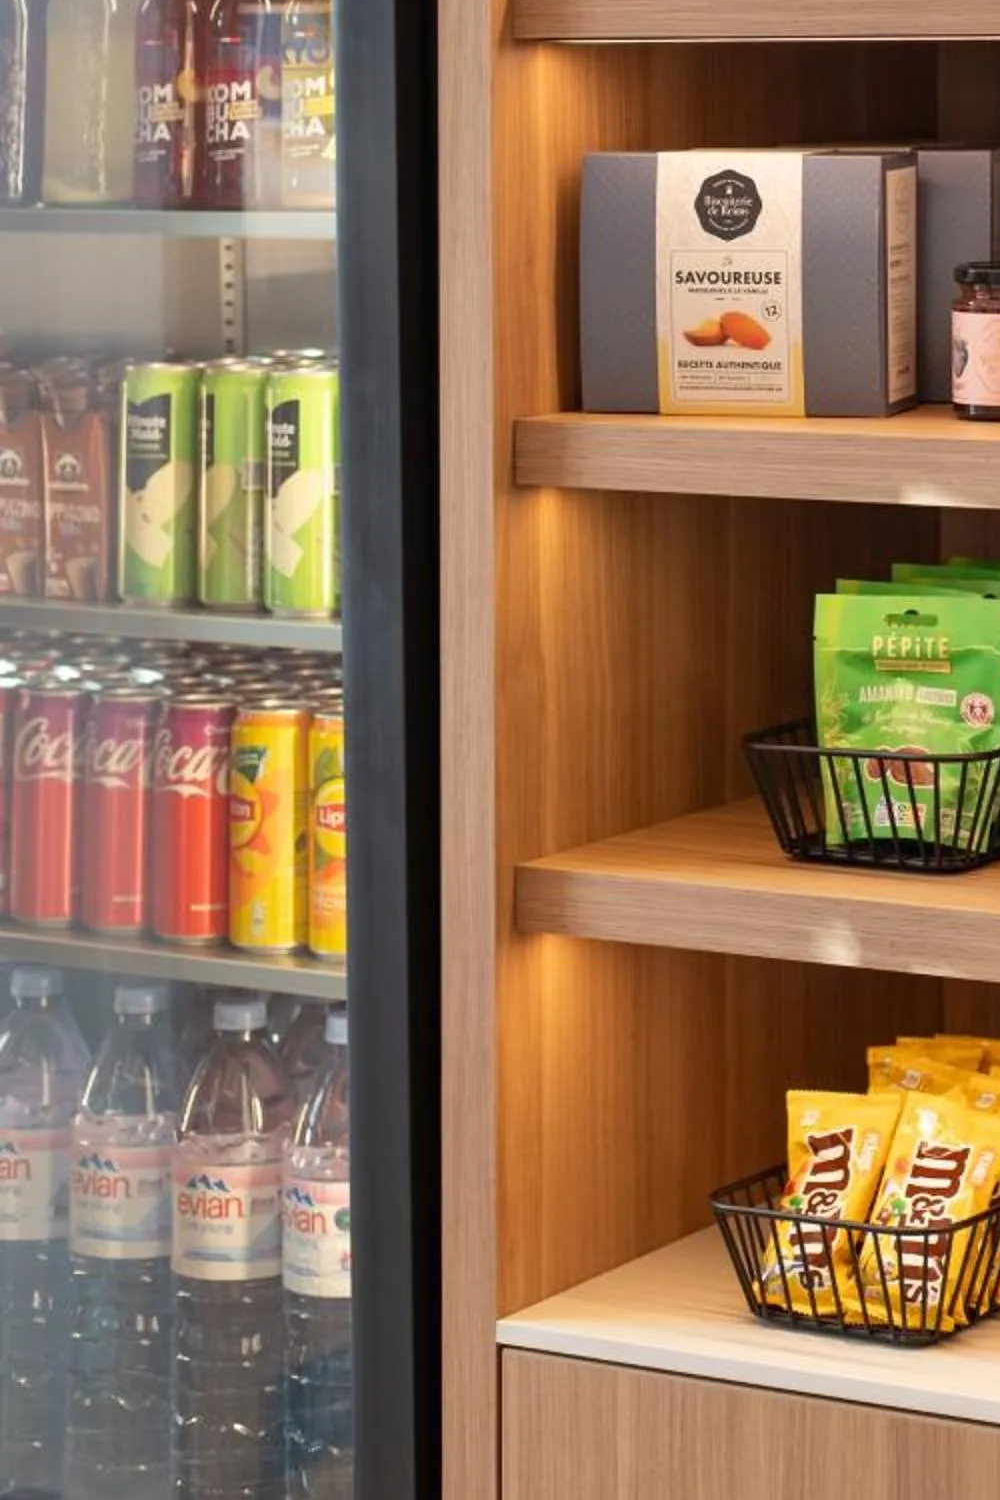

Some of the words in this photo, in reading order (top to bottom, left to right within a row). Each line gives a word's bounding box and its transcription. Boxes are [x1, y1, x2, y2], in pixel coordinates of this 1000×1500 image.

[139, 83, 173, 103] OM
[139, 120, 171, 143] HA
[675, 270, 782, 285] SAVOUREUSE
[765, 304, 779, 317] 12
[715, 360, 782, 371] AUTHENTIQUE
[71, 1169, 133, 1199] evian
[177, 1190, 244, 1221] evian
